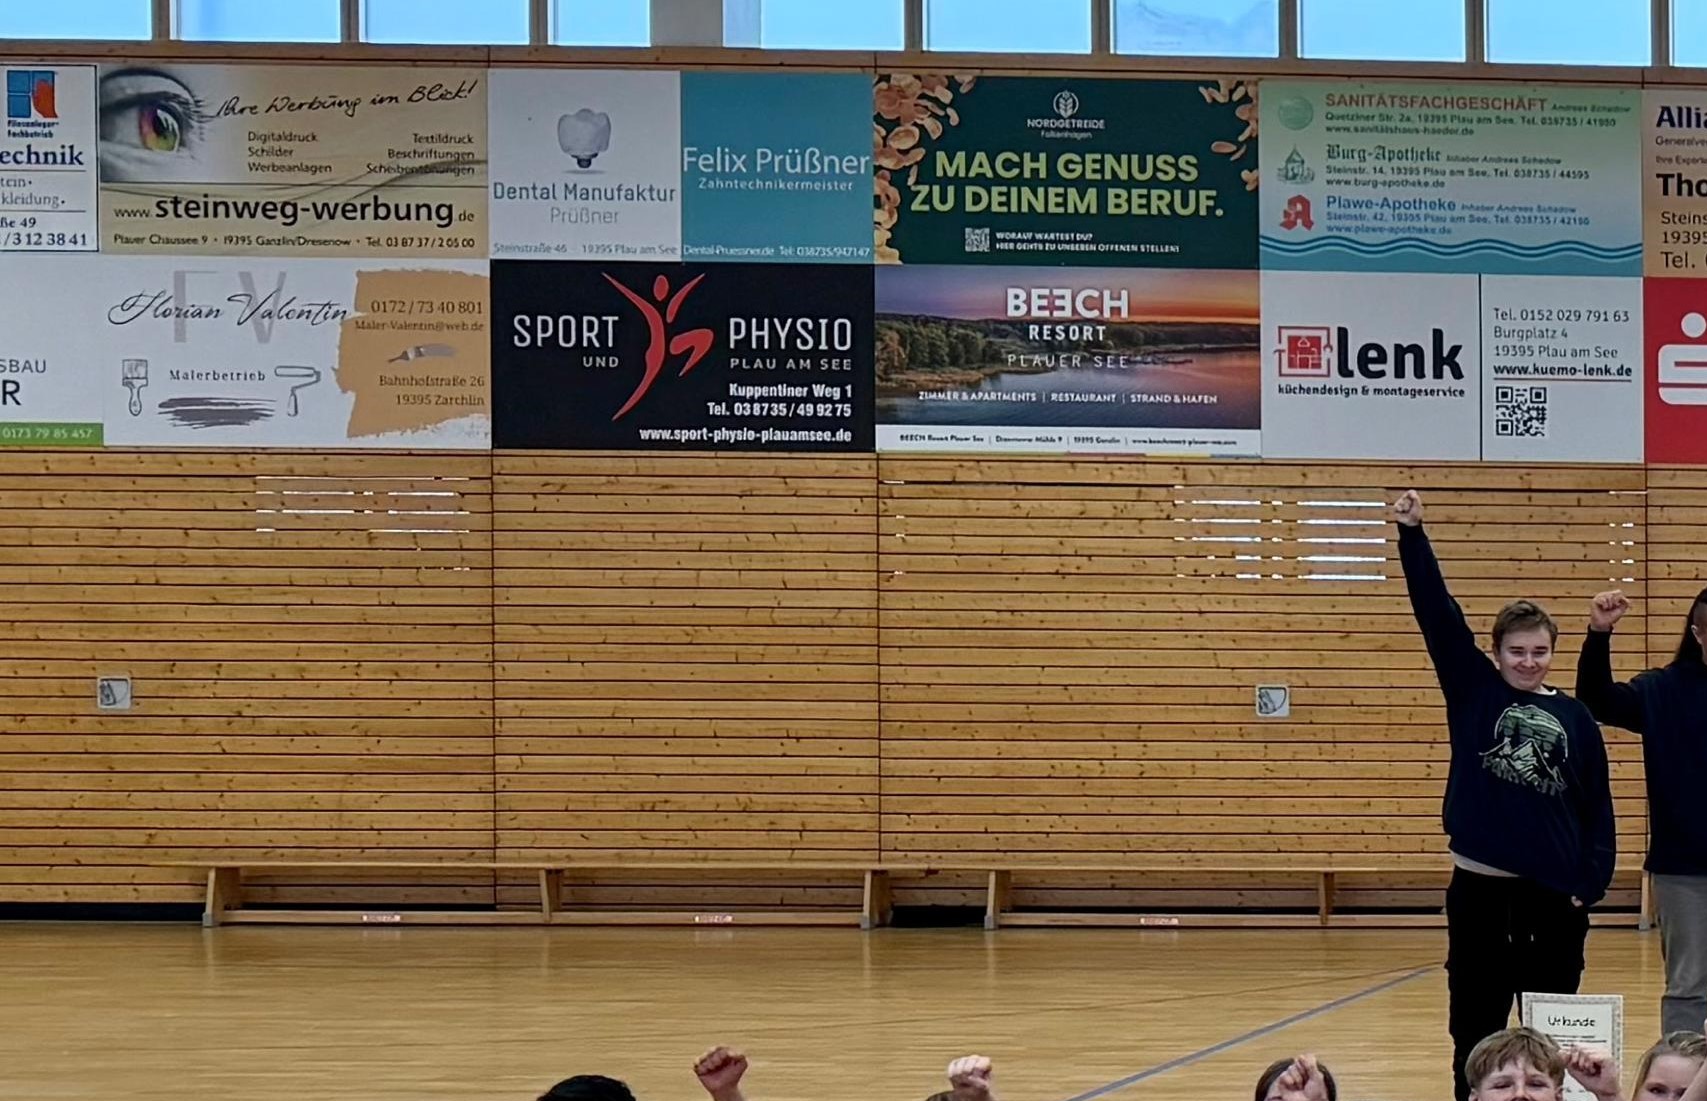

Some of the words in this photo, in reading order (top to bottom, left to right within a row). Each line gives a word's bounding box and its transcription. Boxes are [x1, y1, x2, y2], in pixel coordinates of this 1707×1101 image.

[1325, 93, 1548, 112] SANITÄTSFACHGESCHÄFT
[1027, 118, 1105, 129] NORDGETREIDE
[247, 131, 318, 143] Digitaldruck
[413, 133, 474, 145] Textildruck
[248, 146, 293, 158] Schilder
[387, 148, 475, 161] Beschriftungen
[1325, 144, 1441, 164] Burg-Apotheke
[248, 162, 333, 175] Werbeanlagen
[684, 148, 747, 173] Felix
[756, 149, 870, 175] Prüßner
[935, 151, 1050, 178] MACH
[1056, 152, 1198, 182] GENUSS
[493, 183, 557, 201] Dental
[564, 185, 677, 203] Manufaktur
[699, 178, 853, 192] Zahntechnikermeister
[910, 185, 955, 212] ZU
[965, 186, 1097, 215] DEINEM
[1106, 188, 1224, 217] BERUF.
[1326, 196, 1456, 213] Plawe-Apotheke
[550, 207, 620, 224] Prüßner
[108, 290, 224, 326] Florian
[226, 285, 347, 326] Valentin
[1007, 288, 1130, 319] BEECH
[513, 315, 620, 348] SPORT
[729, 317, 852, 351] PHYSIO
[1029, 324, 1107, 341] RESORT
[1494, 326, 1557, 341] Burgplatz
[1007, 353, 1082, 367] PLAUER
[1093, 355, 1130, 369] SEE
[1337, 326, 1465, 380] lenk
[583, 356, 620, 368] UND
[730, 358, 776, 369] PLAU
[786, 359, 811, 370] AM
[820, 359, 852, 371] SEE
[1493, 362, 1633, 378] www.kuemo-lenk.de
[169, 368, 266, 383] Malerbetrieb
[729, 383, 809, 400] Kuppentiner
[1278, 385, 1358, 398] küchendesign
[1373, 386, 1466, 399] montageservice
[639, 427, 852, 443] www.sport-physio-plauamsee.de
